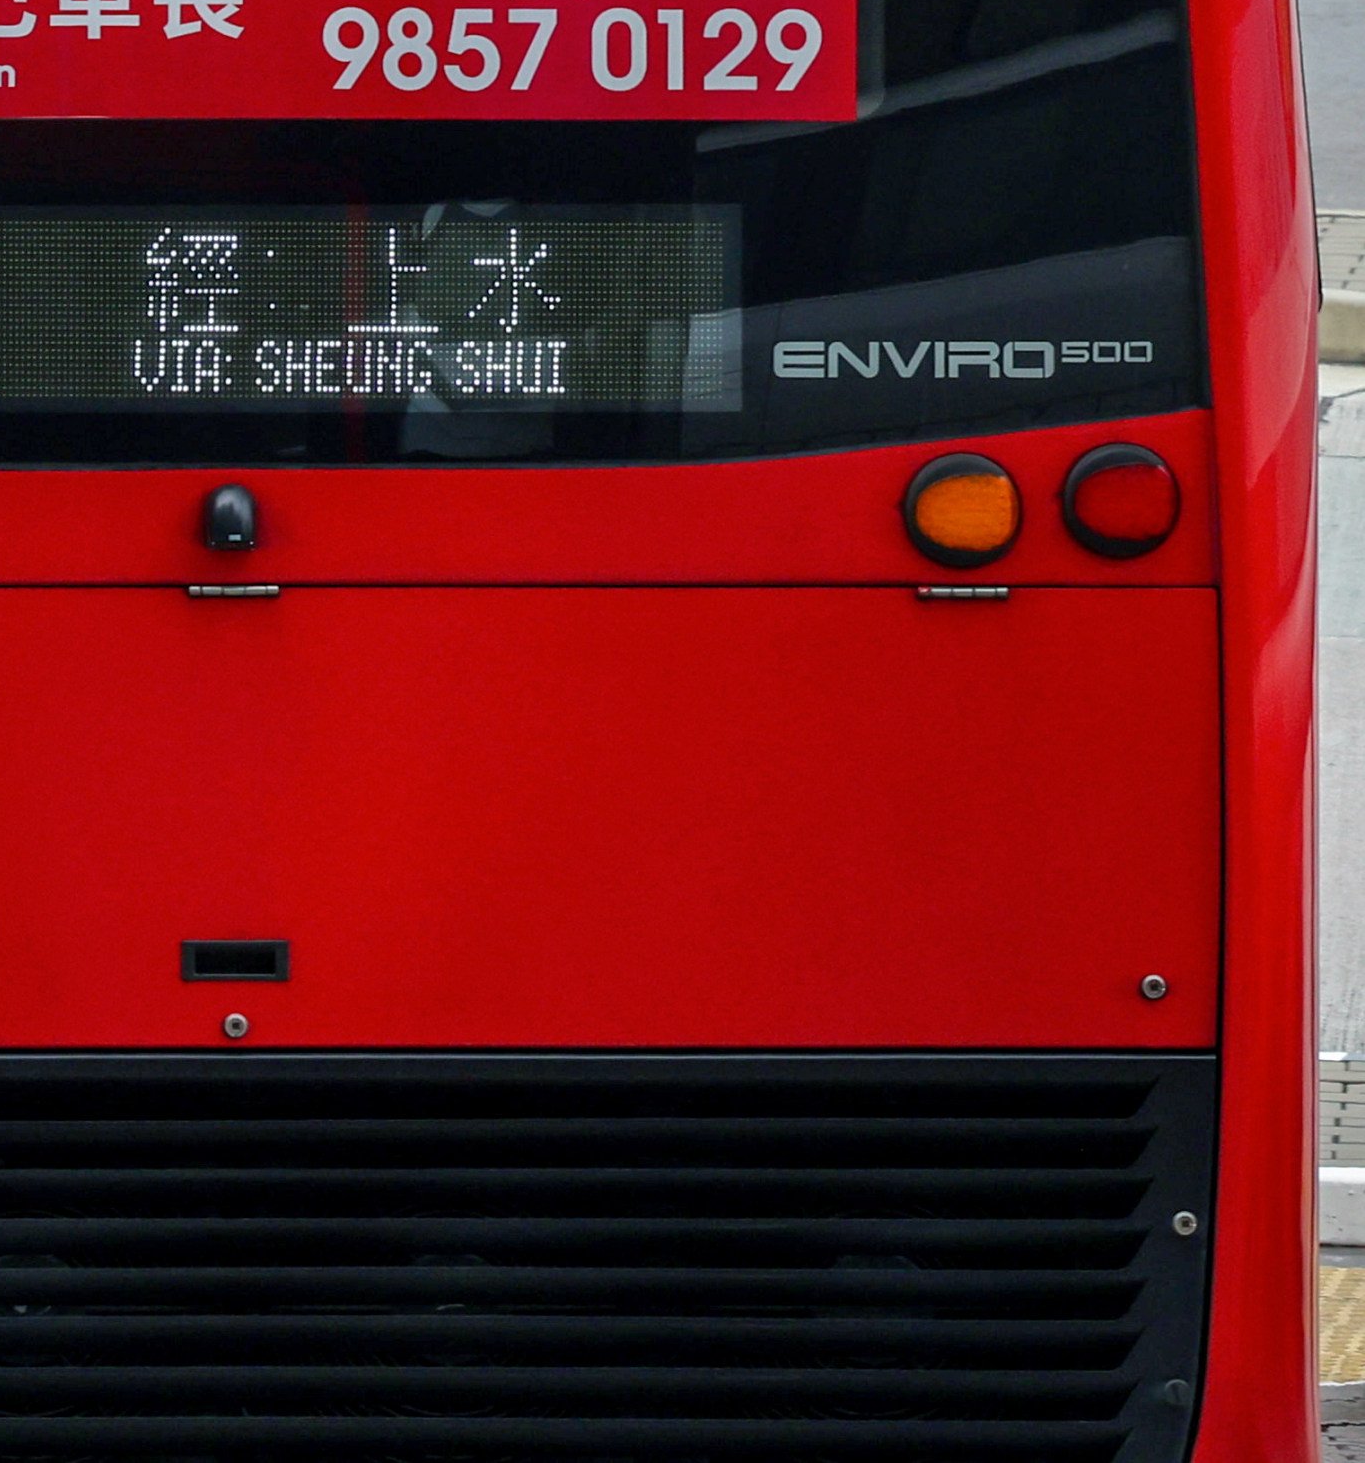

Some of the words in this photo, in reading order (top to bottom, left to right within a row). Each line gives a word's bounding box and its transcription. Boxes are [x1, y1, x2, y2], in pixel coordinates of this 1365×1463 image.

[322, 7, 558, 93] 9857
[591, 7, 823, 93] 0129
[346, 227, 563, 334] 上水
[254, 339, 438, 395] SHEUNG
[455, 339, 568, 395] SHUI
